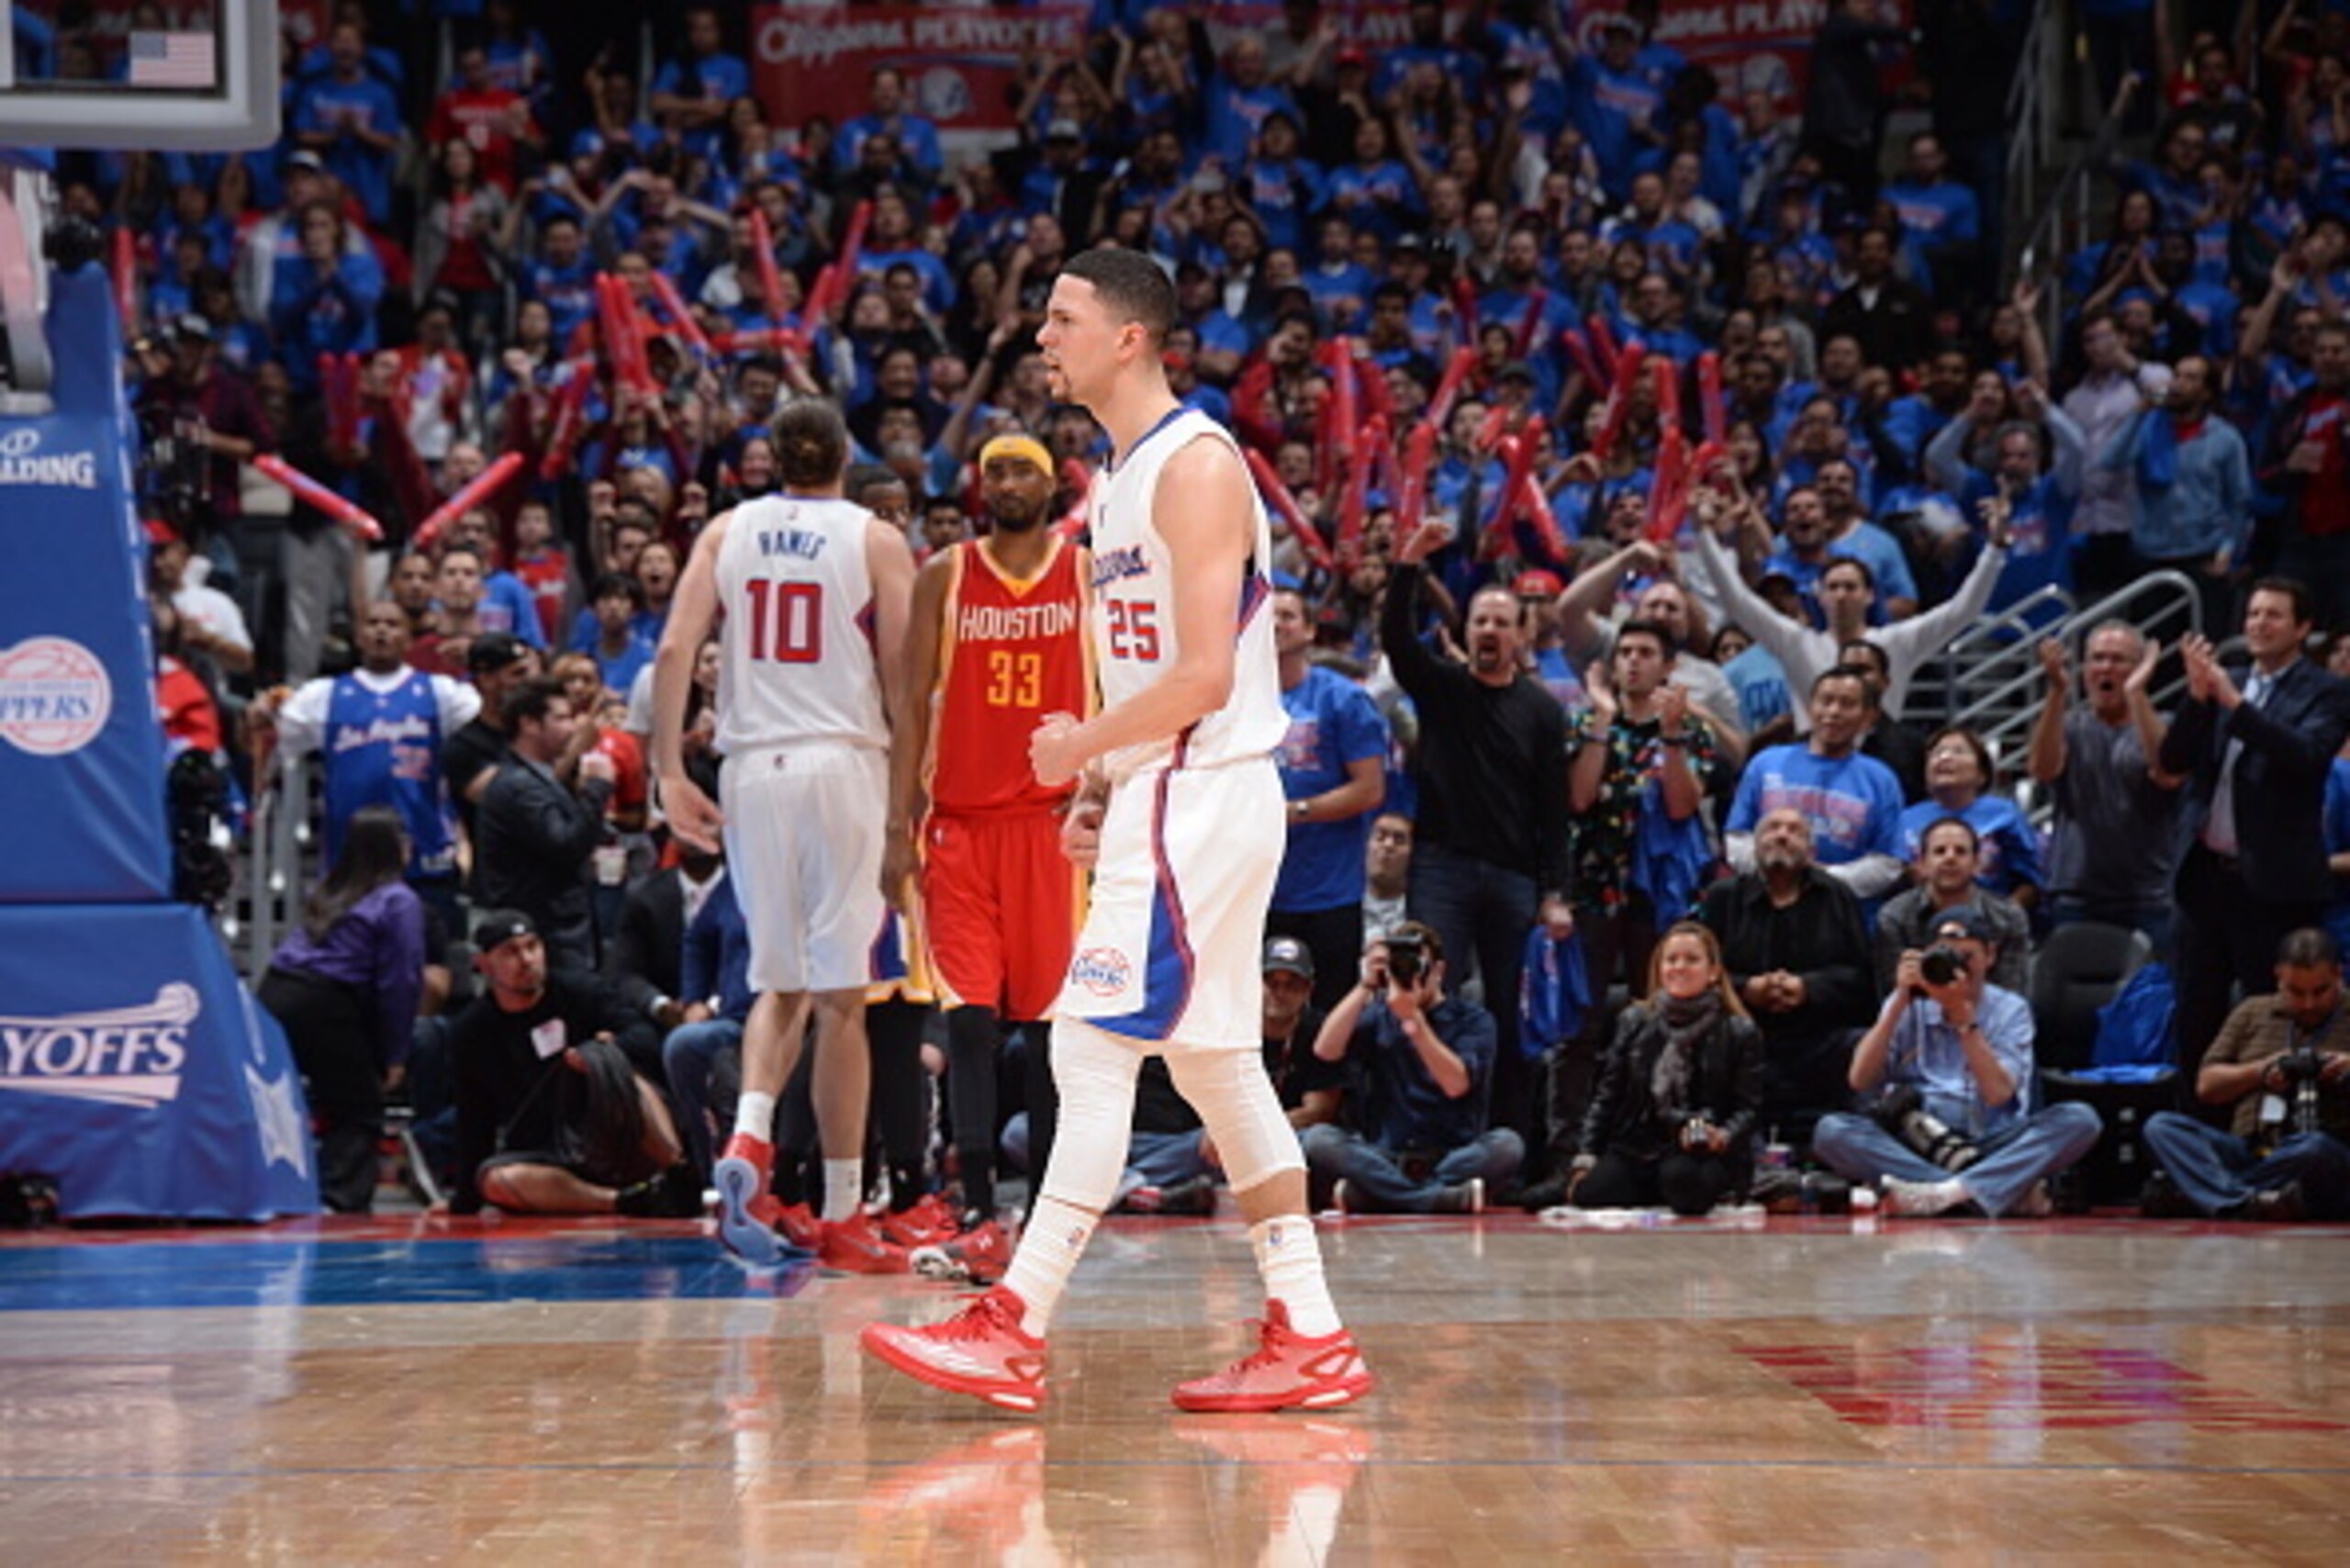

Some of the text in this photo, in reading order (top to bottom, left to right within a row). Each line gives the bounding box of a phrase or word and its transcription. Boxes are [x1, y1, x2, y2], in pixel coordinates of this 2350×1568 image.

[0, 452, 96, 487] LDING
[745, 578, 822, 663] 10
[959, 599, 1076, 642] HOUSTON
[1107, 599, 1160, 661] 25
[988, 650, 1041, 707] 33
[3, 1025, 188, 1075] YOFFS
